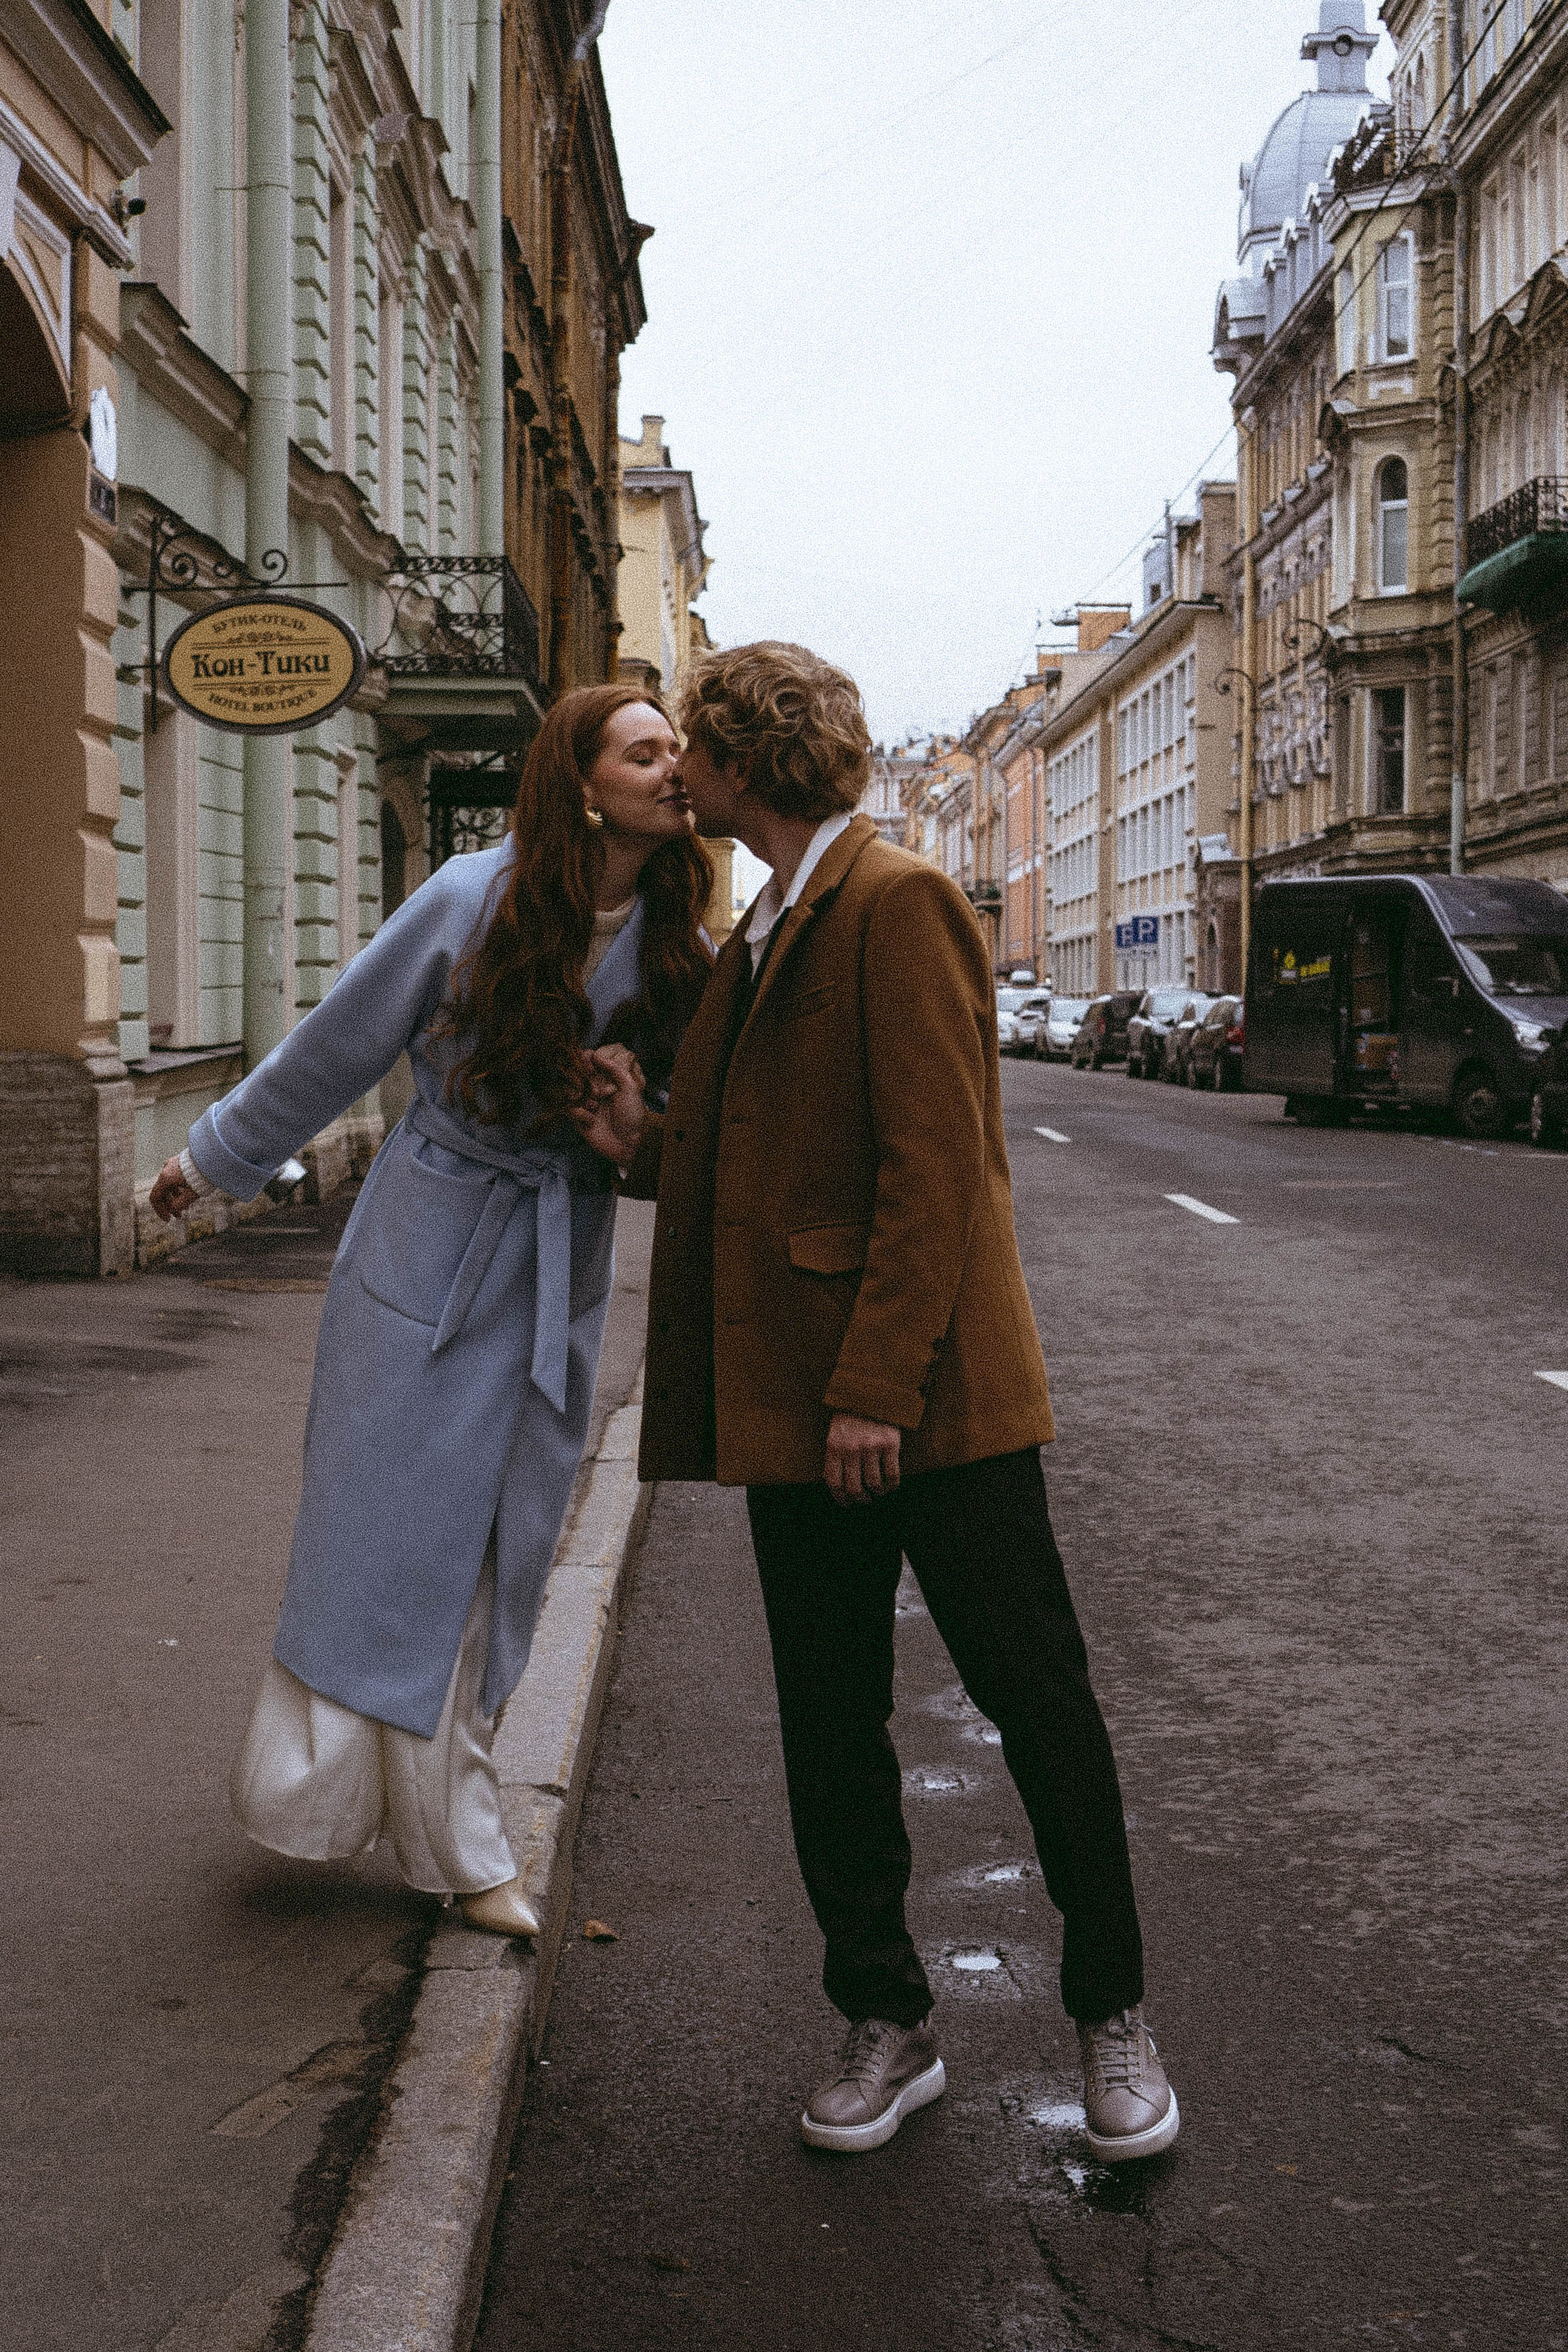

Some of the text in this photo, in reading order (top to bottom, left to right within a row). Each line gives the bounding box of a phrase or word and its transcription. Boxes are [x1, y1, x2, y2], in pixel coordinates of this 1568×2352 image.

[212, 614, 307, 633] БУТИК-ОТЕЛЬ
[191, 650, 330, 678] Кон-Тики
[208, 688, 317, 712] HOTEL BOUTIQUE
[1138, 919, 1155, 941] P
